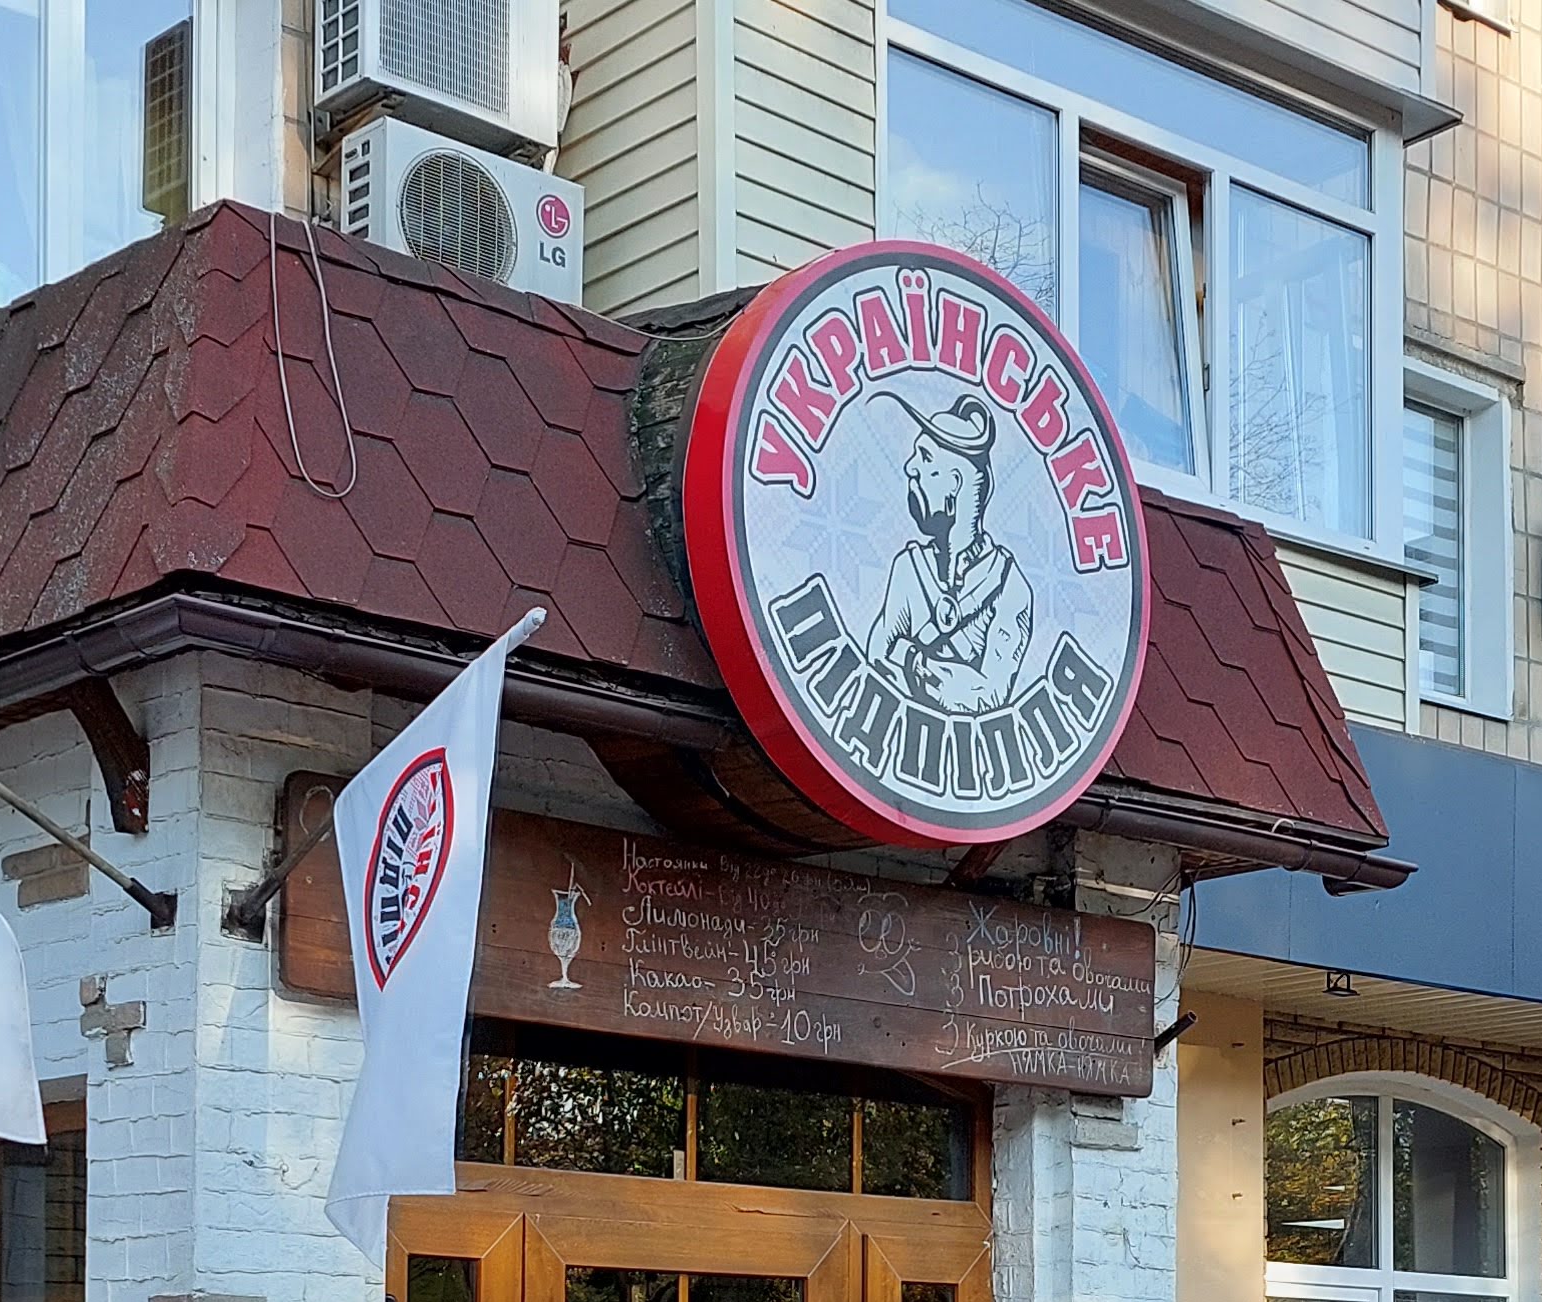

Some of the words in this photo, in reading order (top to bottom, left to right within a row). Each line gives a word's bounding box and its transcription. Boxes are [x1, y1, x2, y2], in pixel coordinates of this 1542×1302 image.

[539, 242, 566, 268] LG
[752, 269, 1128, 571] УКРАЇНСЬКЕ
[771, 576, 1112, 798] ПІДПІЛЛЯ
[728, 967, 763, 1000] 35
[780, 1009, 811, 1045] 10
[814, 1013, 841, 1055] грн
